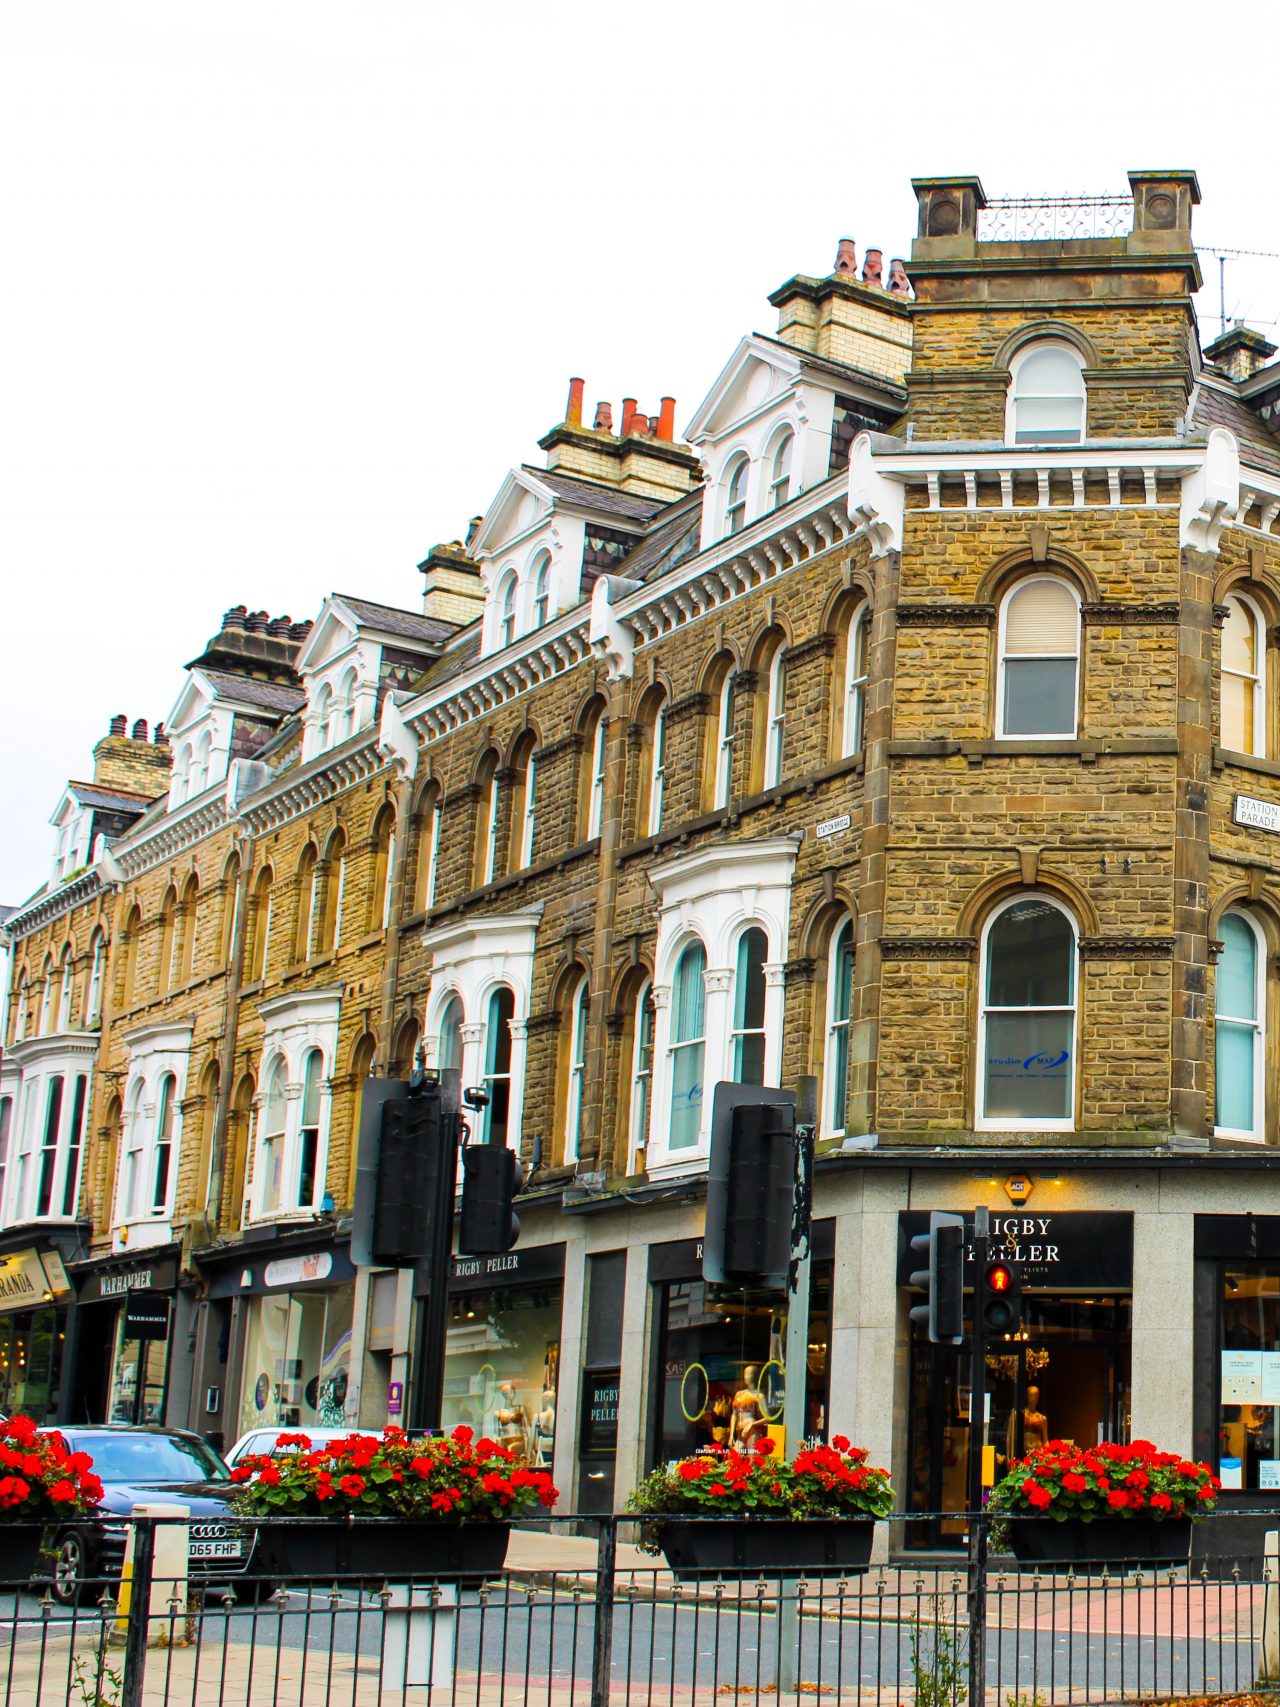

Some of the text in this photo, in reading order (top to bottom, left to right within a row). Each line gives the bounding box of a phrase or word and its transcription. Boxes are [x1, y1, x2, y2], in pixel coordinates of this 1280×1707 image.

[1240, 799, 1278, 816] STATION
[817, 817, 849, 835] STATION BRIDGE
[1241, 811, 1276, 828] PARADE
[989, 1056, 1021, 1064] studio
[1011, 1183, 1025, 1192] ADT
[988, 1218, 1052, 1236] IGBY
[1005, 1233, 1018, 1253] &
[456, 1255, 519, 1277] RIGBY PELLER
[0, 1272, 34, 1298] RANDA
[101, 1270, 152, 1297] WARHAMMER
[128, 1314, 167, 1323] WARHAMMER
[594, 1389, 620, 1402] RIGBY
[189, 1543, 237, 1556] D65 FHF
